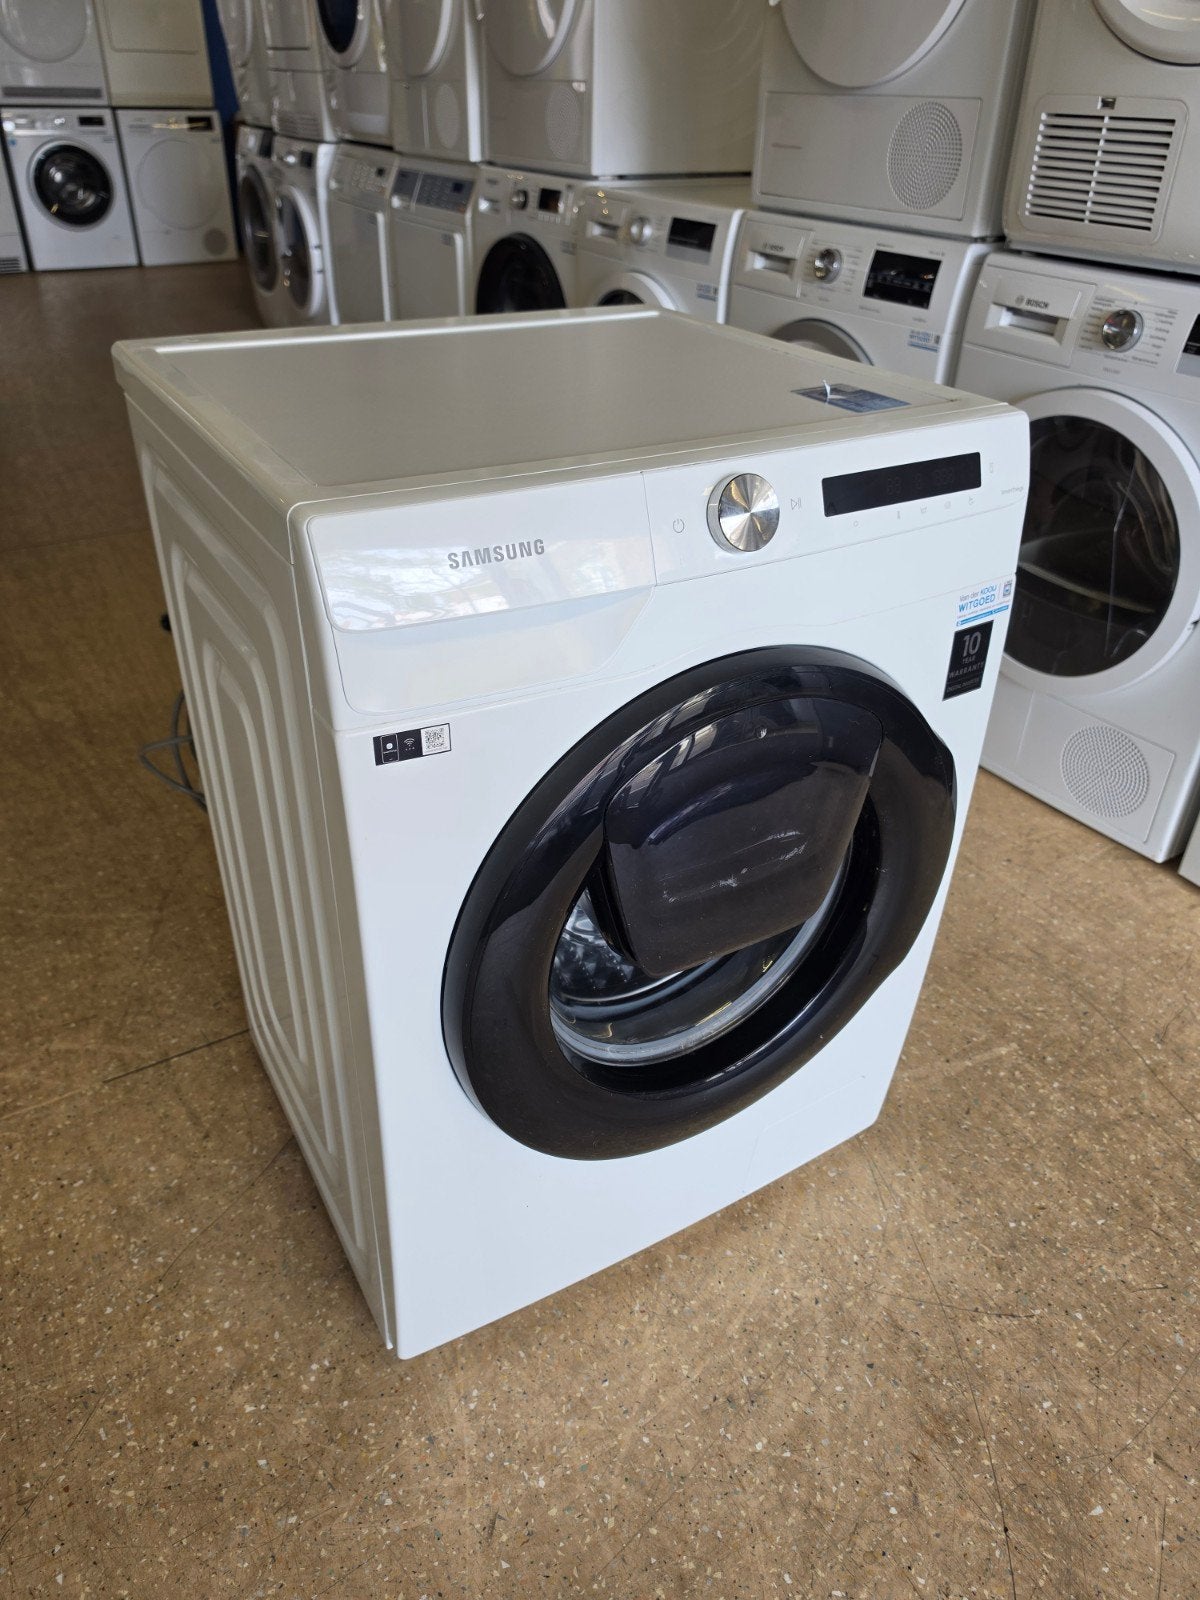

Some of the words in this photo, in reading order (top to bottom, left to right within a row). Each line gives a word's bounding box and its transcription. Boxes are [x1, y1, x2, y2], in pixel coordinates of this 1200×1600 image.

[1025, 297, 1049, 310] BOSCH
[447, 539, 545, 570] SAMSUNG
[959, 594, 995, 612] WITGOED
[963, 631, 981, 657] 10
[962, 655, 976, 665] YEAR
[949, 661, 984, 679] WARRANTY
